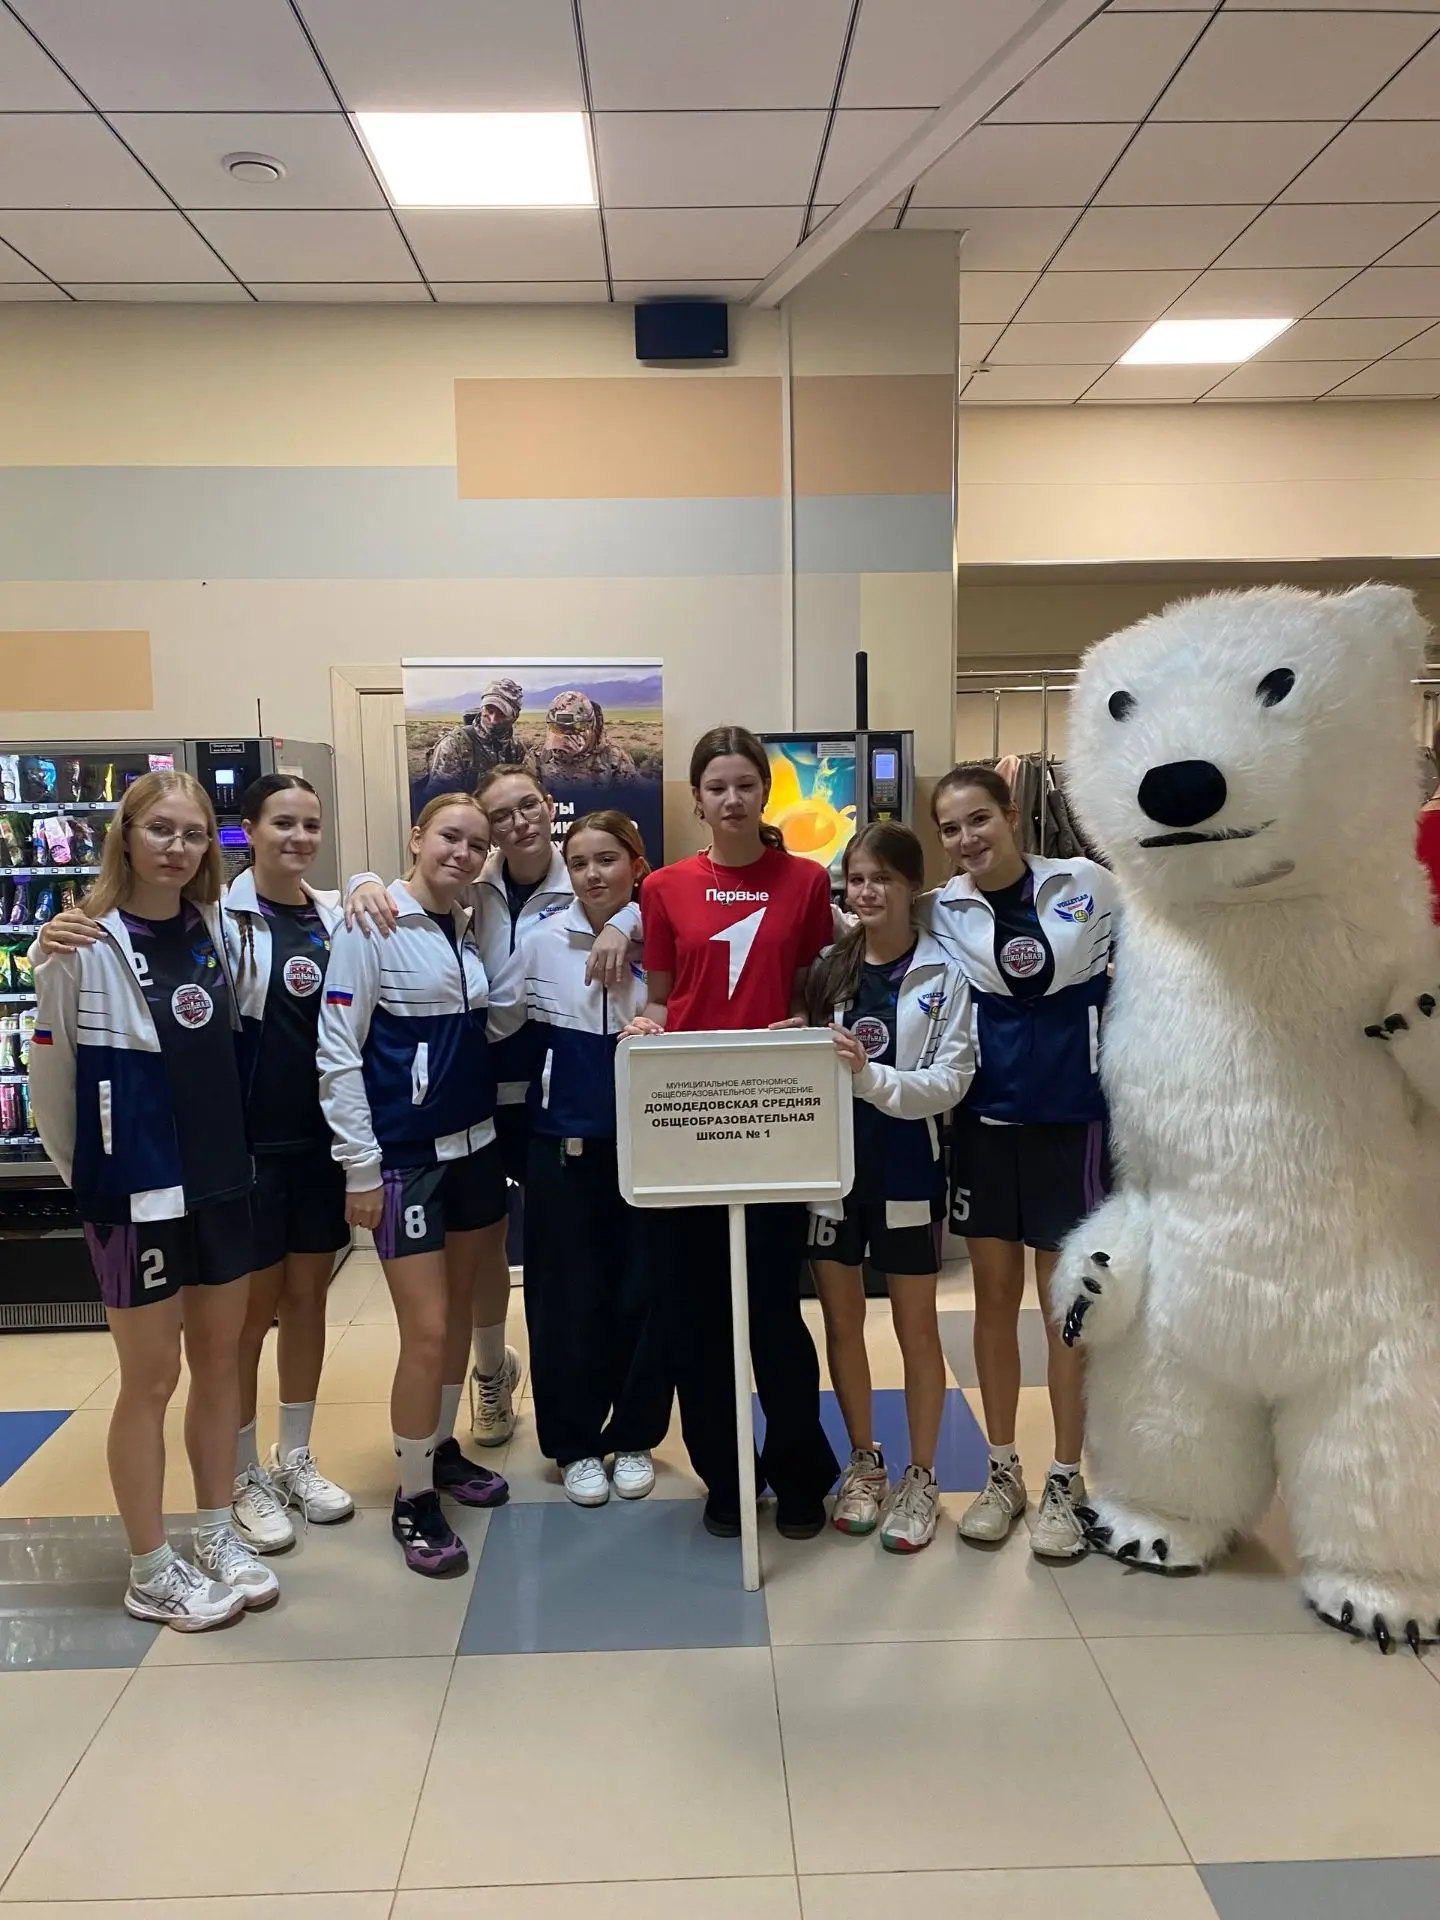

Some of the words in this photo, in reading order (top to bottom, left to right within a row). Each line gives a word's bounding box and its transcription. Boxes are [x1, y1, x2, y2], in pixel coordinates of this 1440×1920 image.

[705, 888, 769, 904] Первые
[666, 1080, 739, 1090] МУНИЦИПАЛЬНОЕ
[741, 1077, 798, 1087] АВТОНОМНОЕ
[651, 1088, 756, 1099] ОБЩЕОБРАЗОВАТЕЛЬНОЕ
[758, 1085, 814, 1096] УЧРЕЖДЕНИЕ
[644, 1100, 758, 1114] ДОМОДЕДОВСКАЯ
[762, 1097, 821, 1108] СРЕДНЯЯ
[651, 1113, 815, 1128] ОБЩЕОБРАЗОВАТЕЛЬНАЯ
[696, 1130, 742, 1141] ШКОЛА
[746, 1130, 760, 1139] №
[764, 1129, 770, 1138] 1
[952, 1187, 971, 1221] 5
[404, 1204, 427, 1239] 8
[807, 1212, 838, 1247] 16
[140, 1248, 167, 1290] 2
